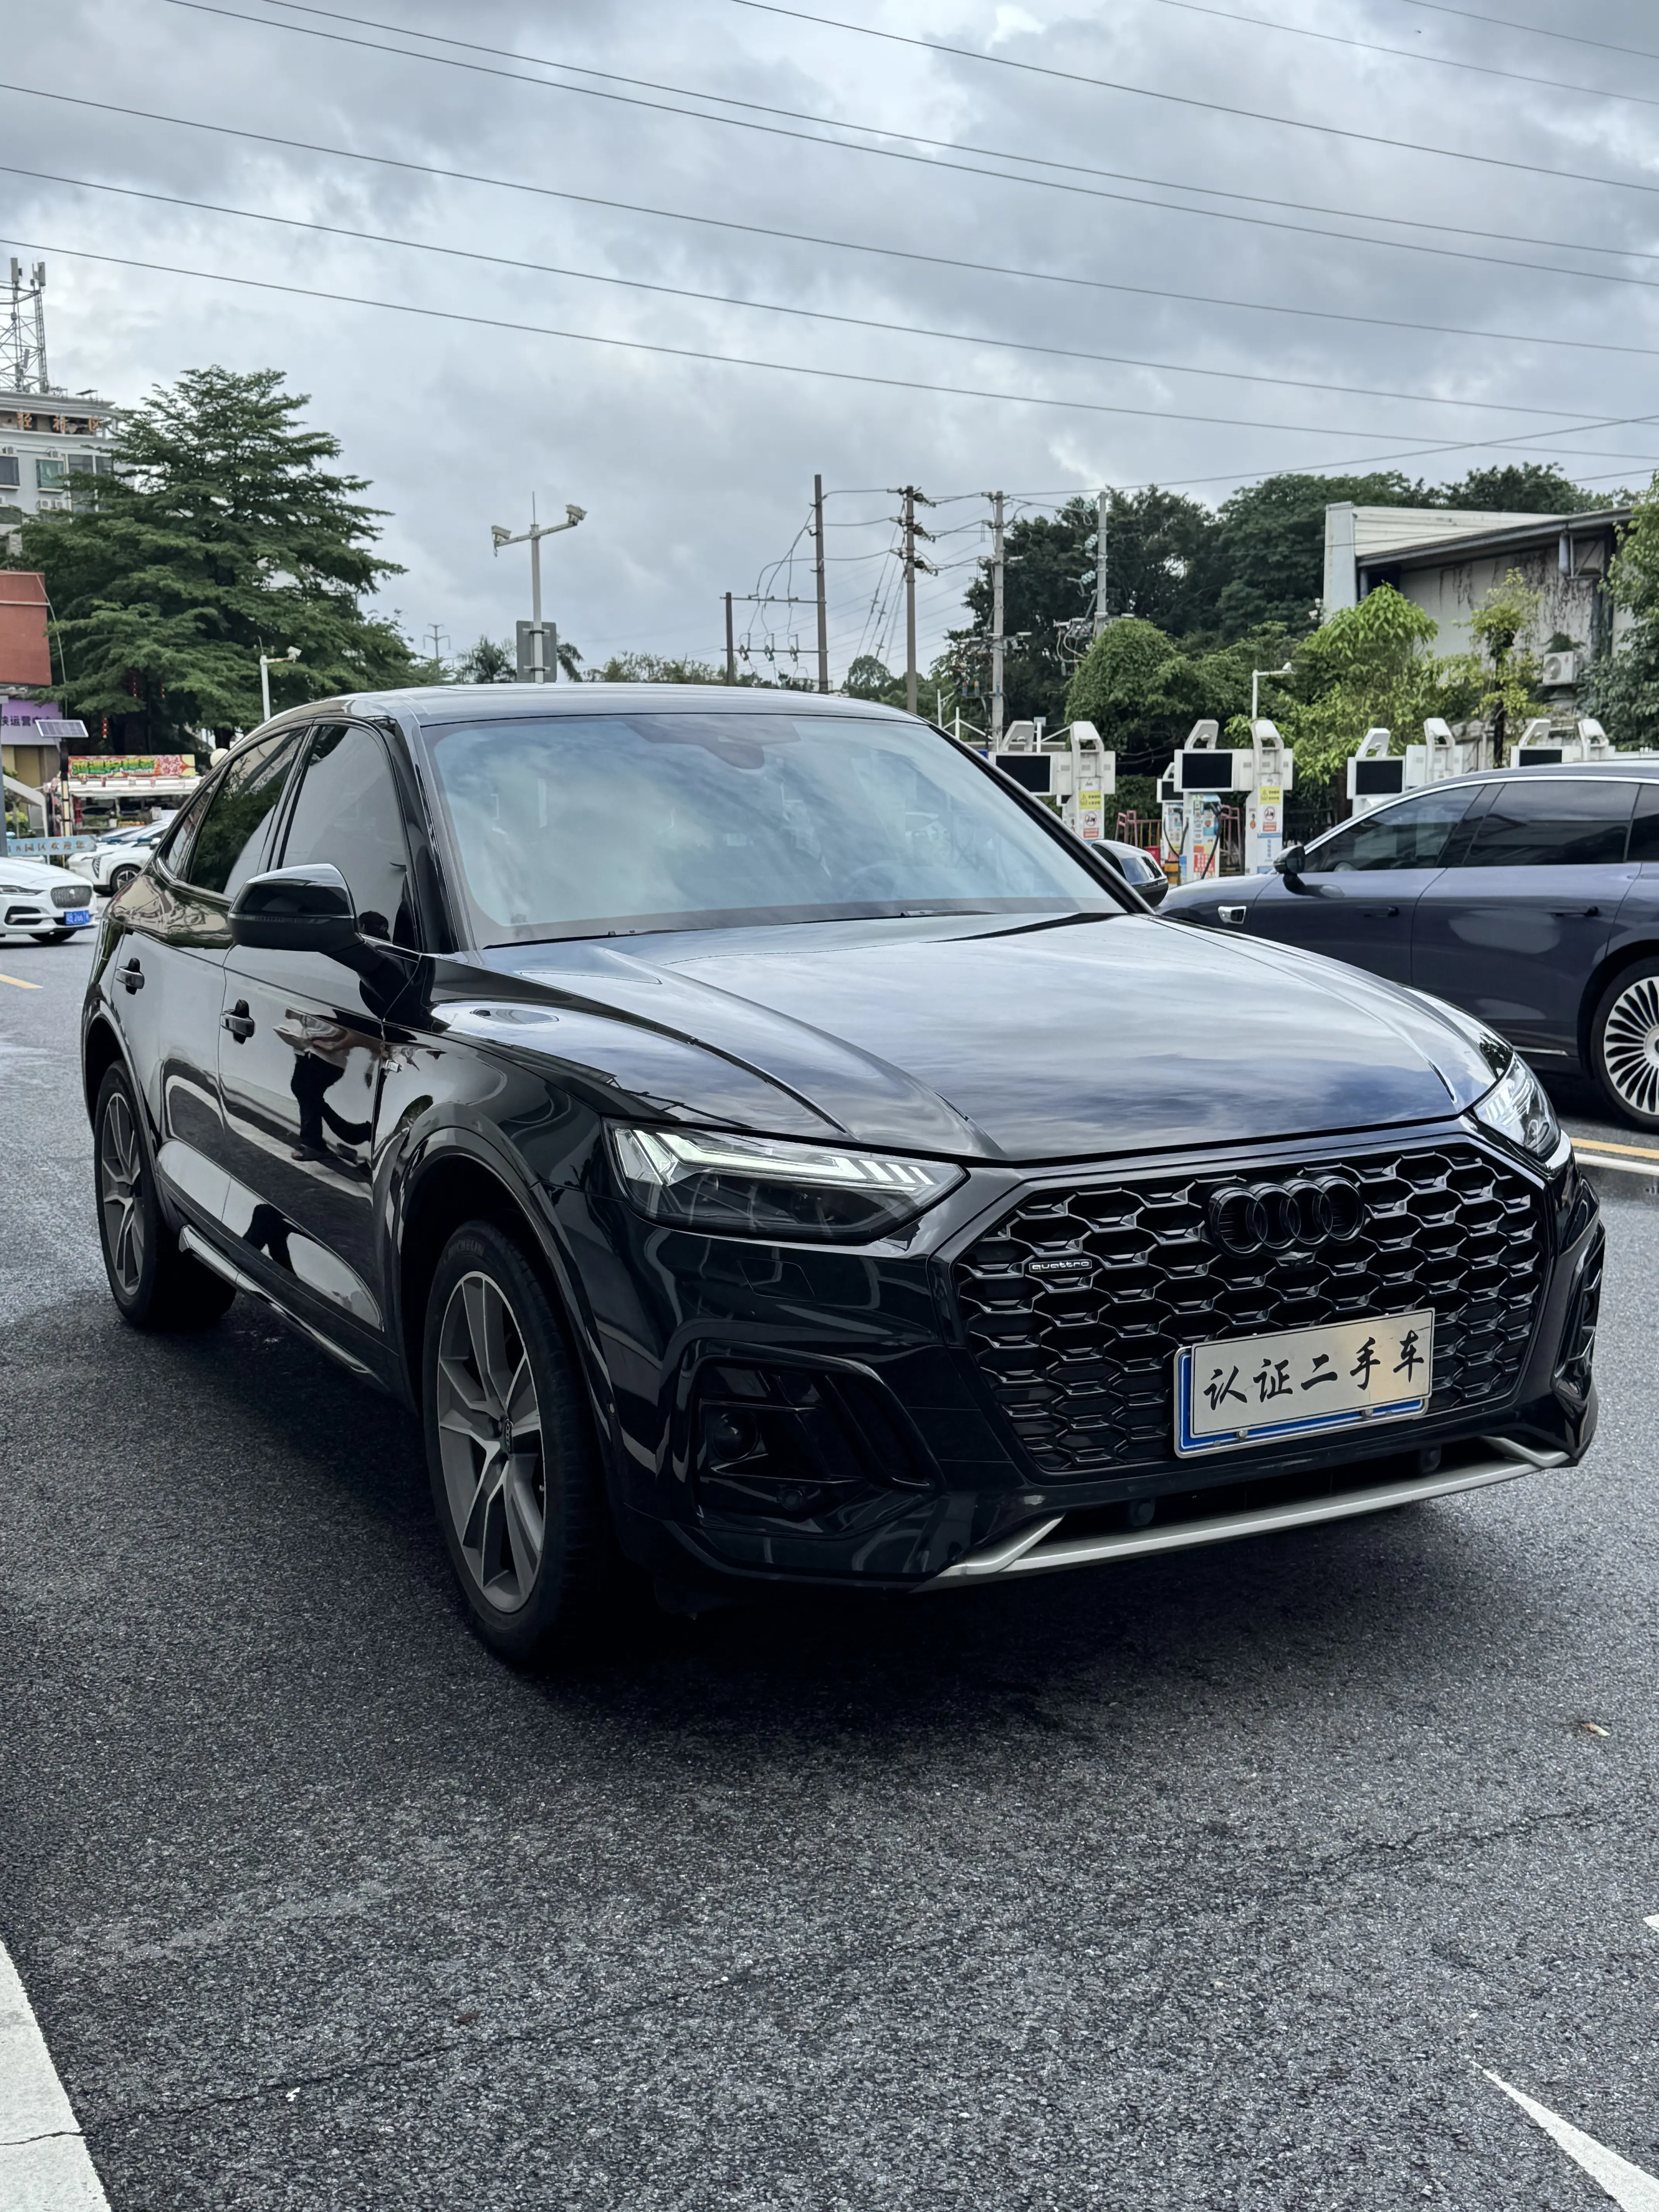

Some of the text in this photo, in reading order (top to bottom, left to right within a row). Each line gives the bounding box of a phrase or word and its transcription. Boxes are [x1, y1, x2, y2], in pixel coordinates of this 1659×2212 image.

[1032, 1262, 1089, 1271] quattro
[1203, 1330, 1424, 1410] 认证二手车
